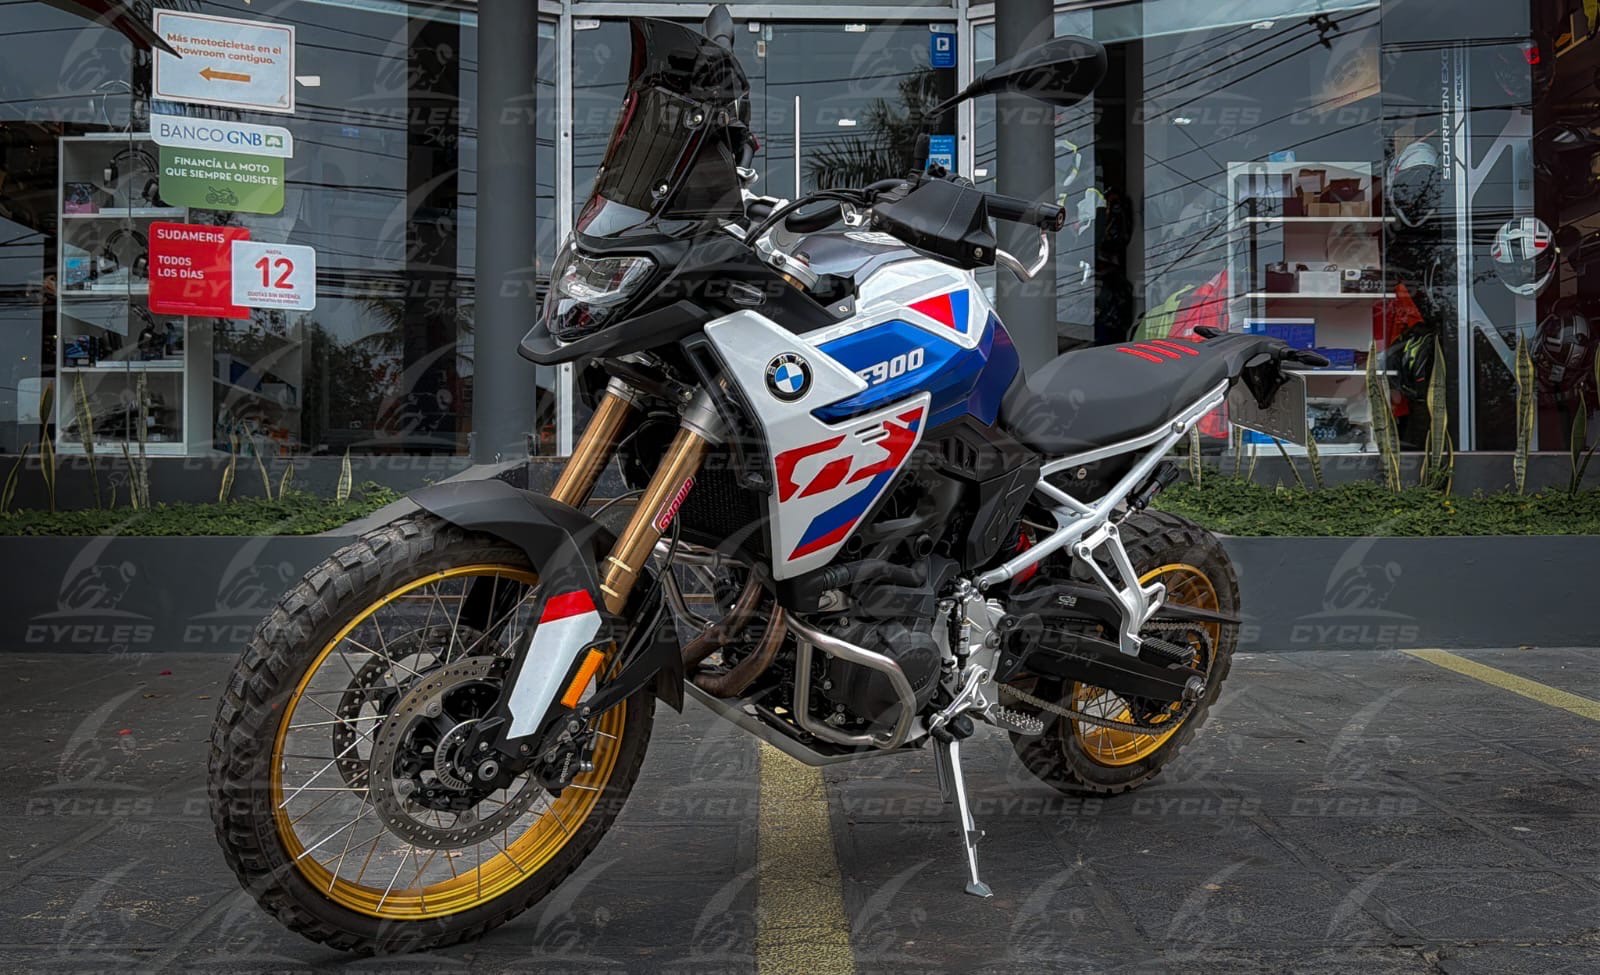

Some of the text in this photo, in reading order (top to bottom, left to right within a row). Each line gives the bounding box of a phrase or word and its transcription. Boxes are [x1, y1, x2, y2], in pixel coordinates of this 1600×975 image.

[167, 33, 282, 54] Más motocicletas en el
[228, 52, 275, 64] contiguo.
[160, 123, 262, 146] BANCO GNB
[1441, 87, 1451, 180] SCORPION
[174, 156, 270, 173] FINANCÍA LA MOTO
[165, 167, 278, 186] QUE SIEMPRE QUISISTE
[157, 228, 225, 243] SUDAMERIS
[157, 255, 192, 266] TODOS
[157, 267, 204, 279] LOS DÍAS
[255, 256, 294, 289] 12
